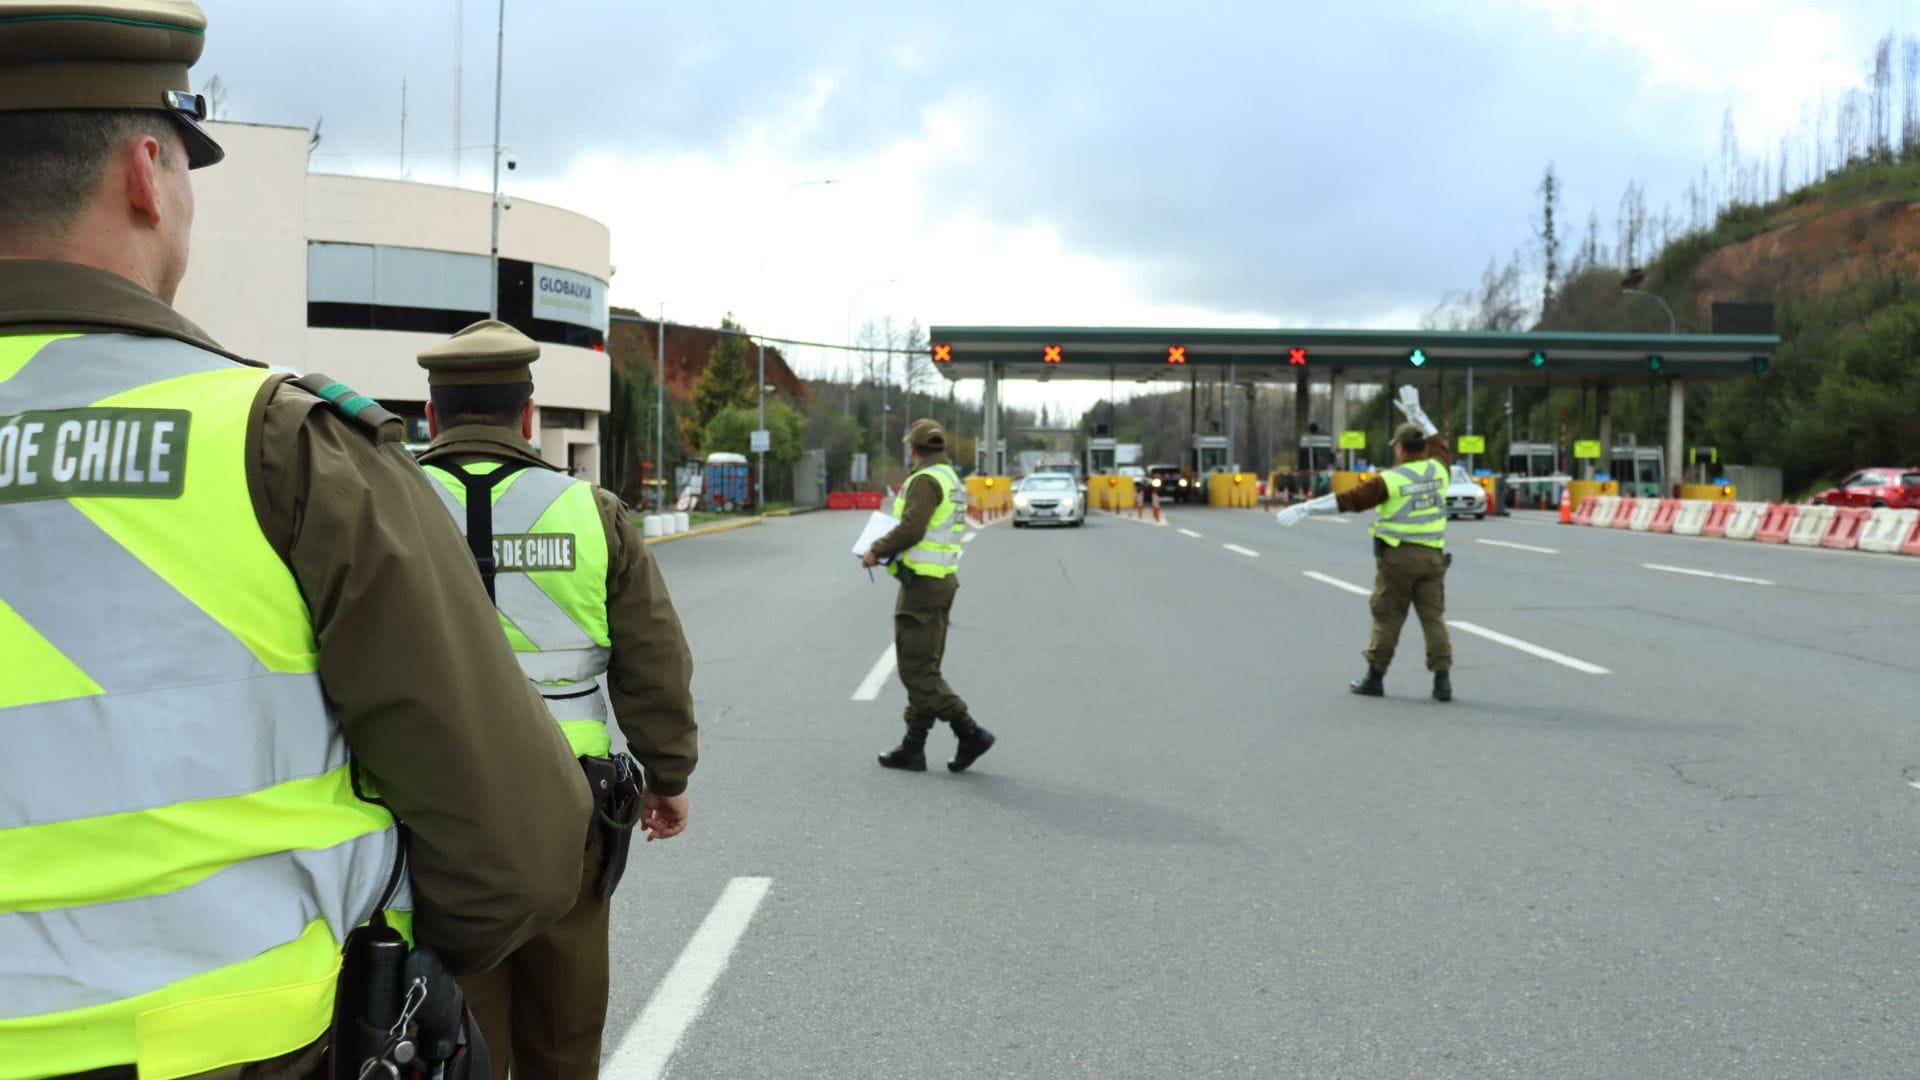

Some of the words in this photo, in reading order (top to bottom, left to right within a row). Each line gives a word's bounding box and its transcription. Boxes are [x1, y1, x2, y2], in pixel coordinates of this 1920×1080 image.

[540, 276, 592, 299] GLOBALVIA
[0, 423, 45, 487] DE
[52, 420, 175, 483] CHILE
[503, 539, 523, 567] DE
[526, 538, 571, 567] CHILE
